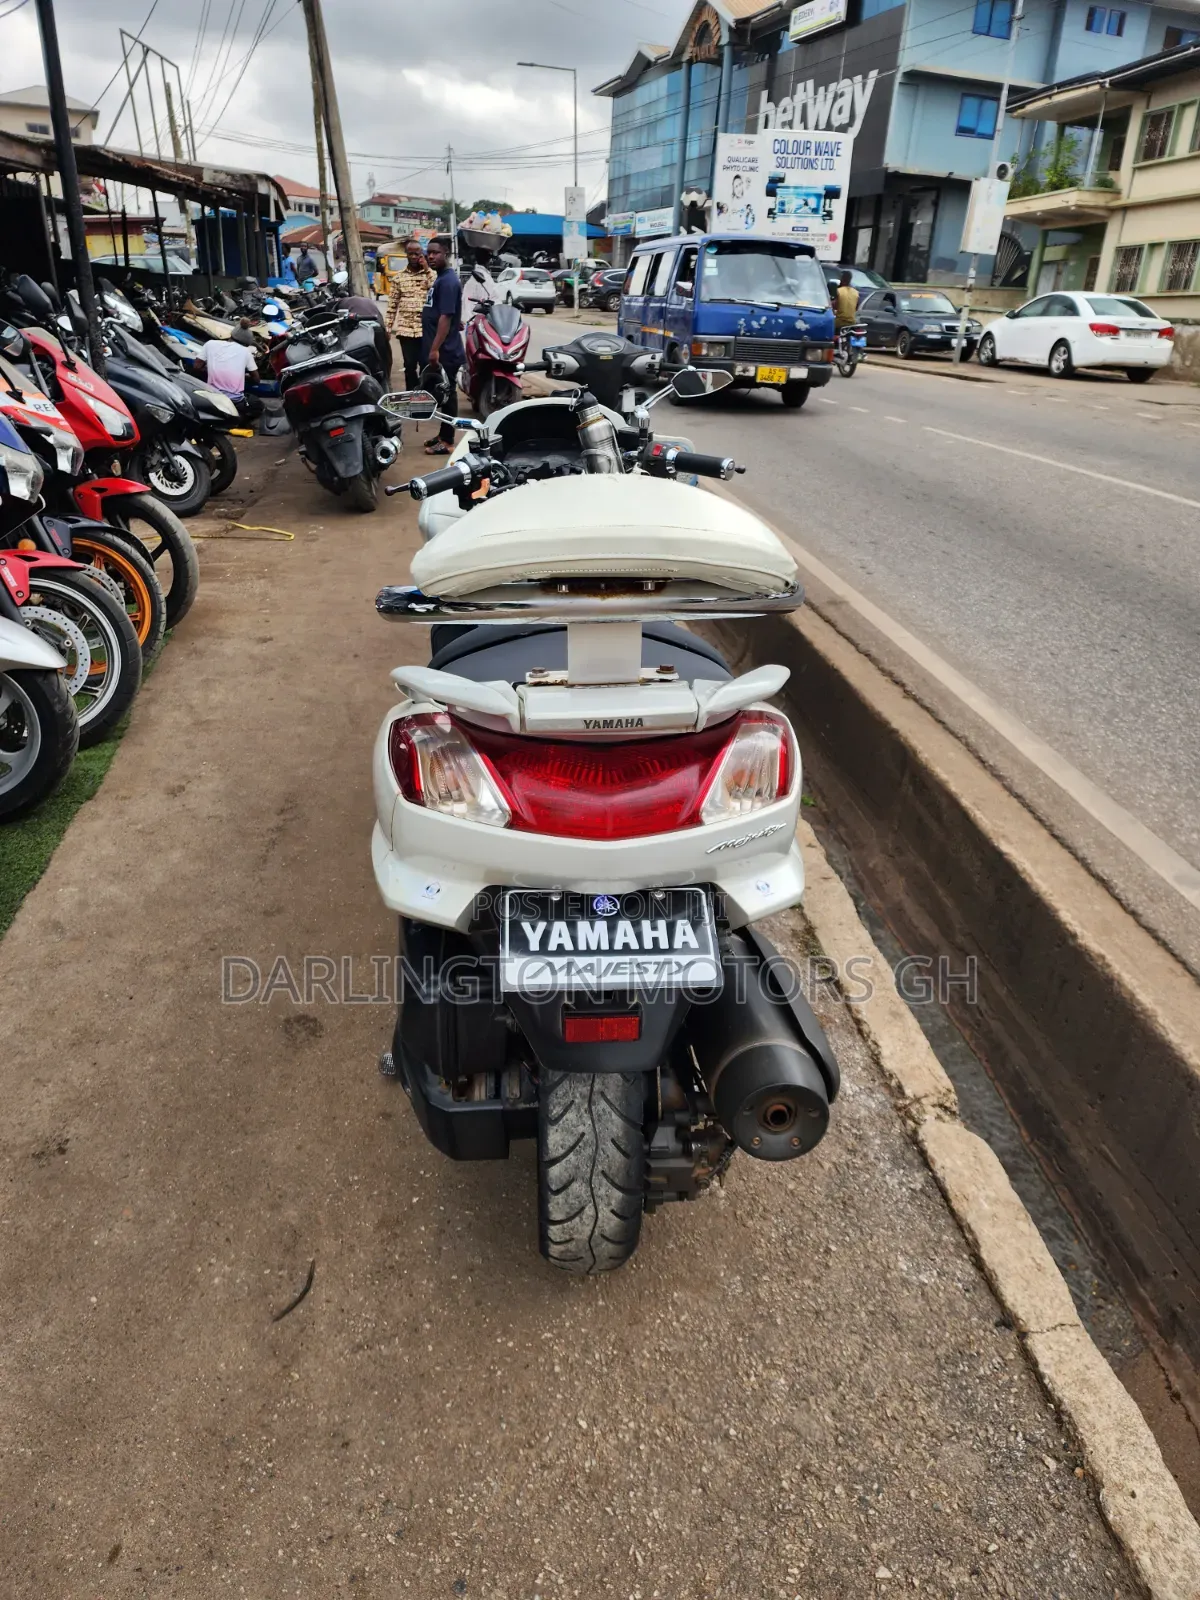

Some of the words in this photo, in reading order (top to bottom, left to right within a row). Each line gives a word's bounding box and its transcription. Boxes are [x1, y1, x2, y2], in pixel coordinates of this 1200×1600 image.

[757, 69, 879, 139] betway
[773, 138, 812, 155] COLOUR
[814, 141, 842, 157] WAVE
[727, 156, 759, 164] QUALICARE
[775, 156, 819, 171] SOLUTIONS
[821, 158, 837, 171] LTD.
[584, 718, 644, 730] YAMAHA
[520, 919, 699, 952] YAMAHA
[526, 959, 698, 980] MAJESTY
